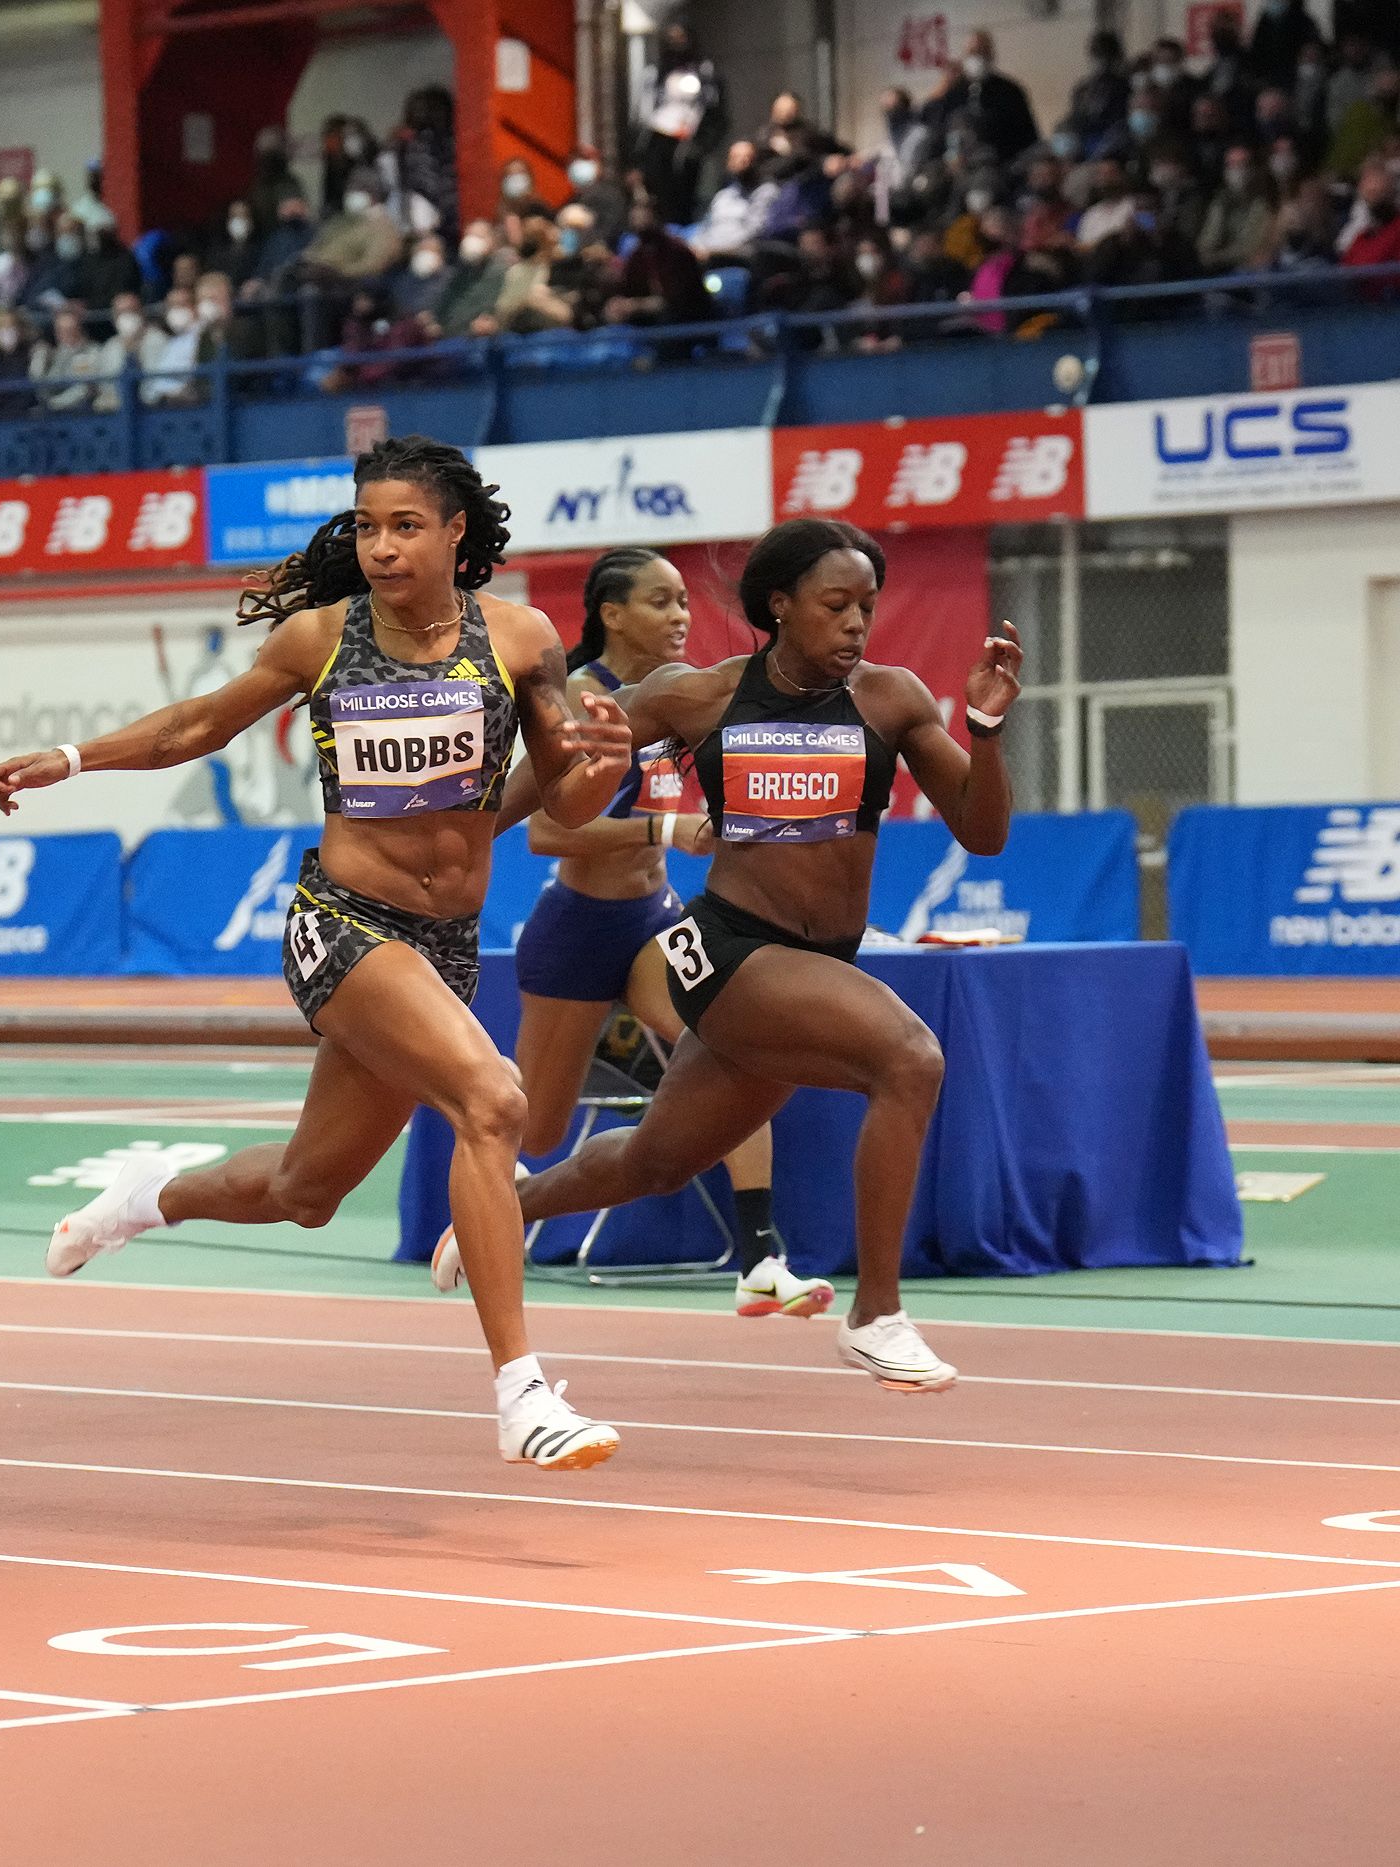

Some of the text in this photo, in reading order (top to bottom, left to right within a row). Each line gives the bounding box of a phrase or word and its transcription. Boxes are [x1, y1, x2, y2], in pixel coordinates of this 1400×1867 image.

[1154, 401, 1350, 464] UCS
[547, 486, 608, 524] NY
[444, 675, 489, 686] adidas
[340, 691, 478, 712] MILLROSE GAMES
[354, 731, 474, 773] HOBBS
[728, 733, 860, 747] MILLROSE GAMES
[747, 772, 840, 800] BRISCO
[1269, 915, 1328, 946] new
[668, 926, 704, 981] 3
[704, 1563, 1028, 1598] 4
[47, 1622, 452, 1672] 5
